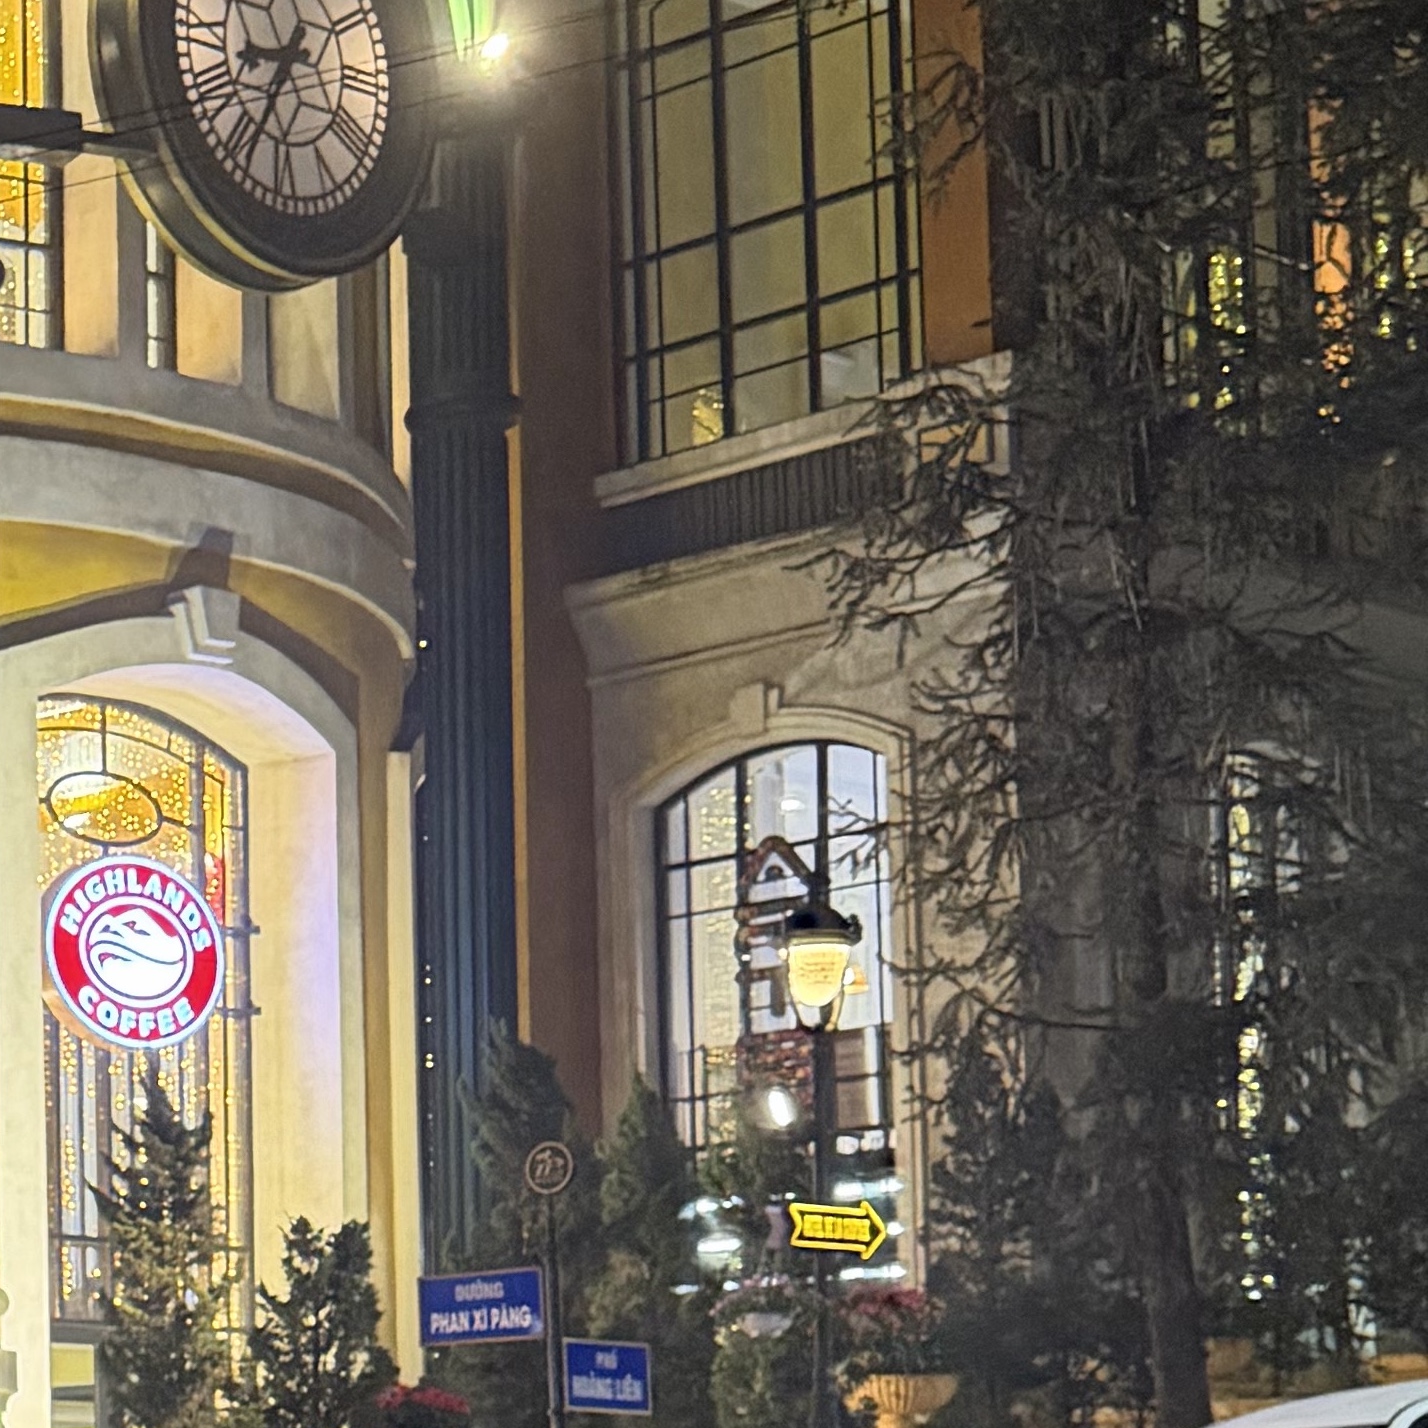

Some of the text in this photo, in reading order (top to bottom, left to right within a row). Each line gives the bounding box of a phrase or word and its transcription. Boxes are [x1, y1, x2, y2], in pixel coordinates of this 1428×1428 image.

[59, 867, 213, 952] HIGHLANDS
[78, 985, 195, 1037] COFFEE
[430, 1310, 470, 1335] PHAN
